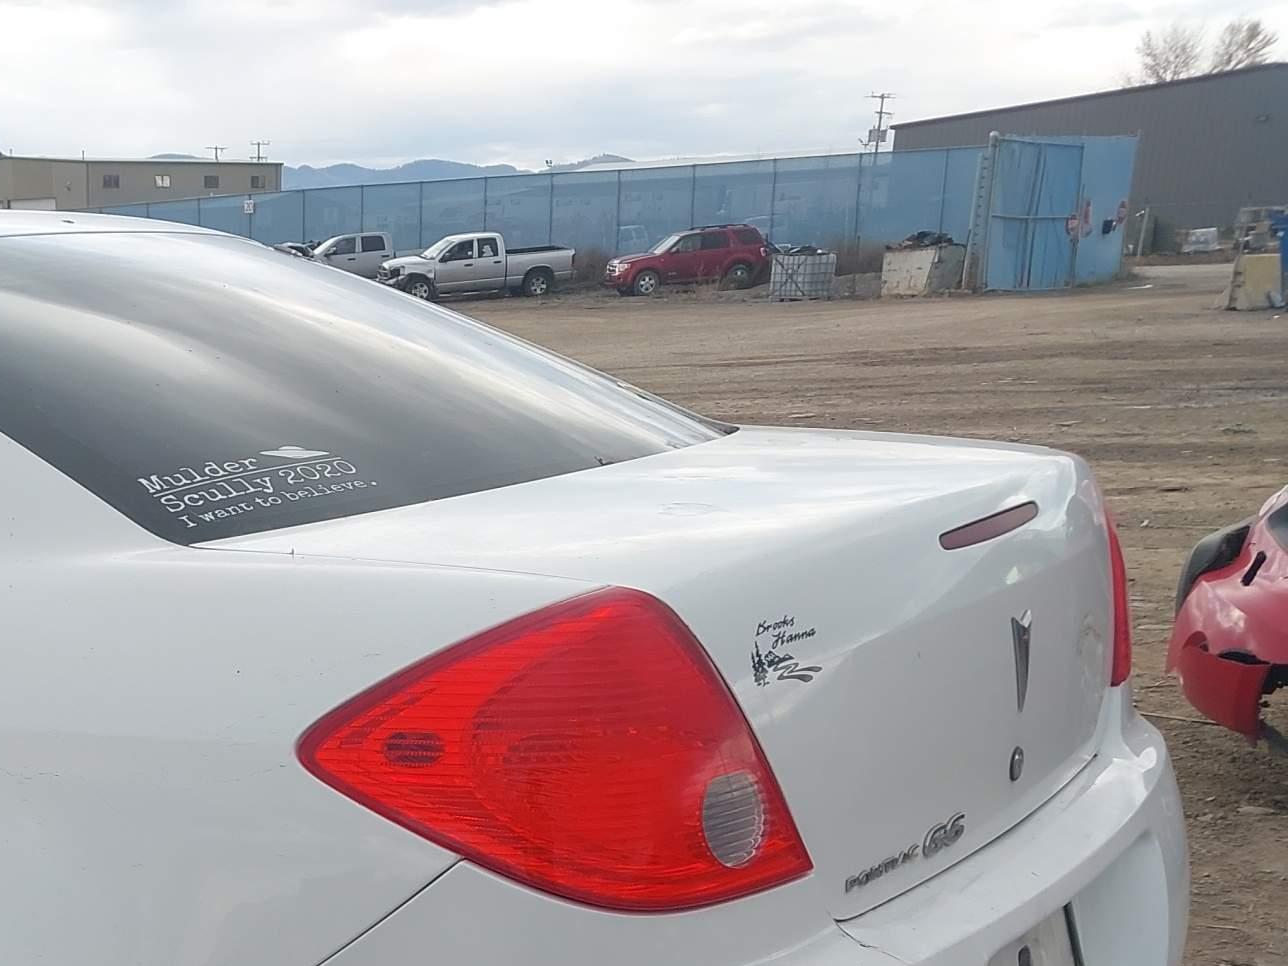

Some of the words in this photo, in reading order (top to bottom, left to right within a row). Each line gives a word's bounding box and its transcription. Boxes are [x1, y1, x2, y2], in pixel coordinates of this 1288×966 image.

[137, 457, 258, 494] Mulder
[160, 476, 275, 514] Scully
[278, 459, 357, 485] 2020
[178, 514, 197, 528] I
[199, 501, 254, 523] want
[255, 494, 282, 508] to
[922, 811, 966, 858] G6
